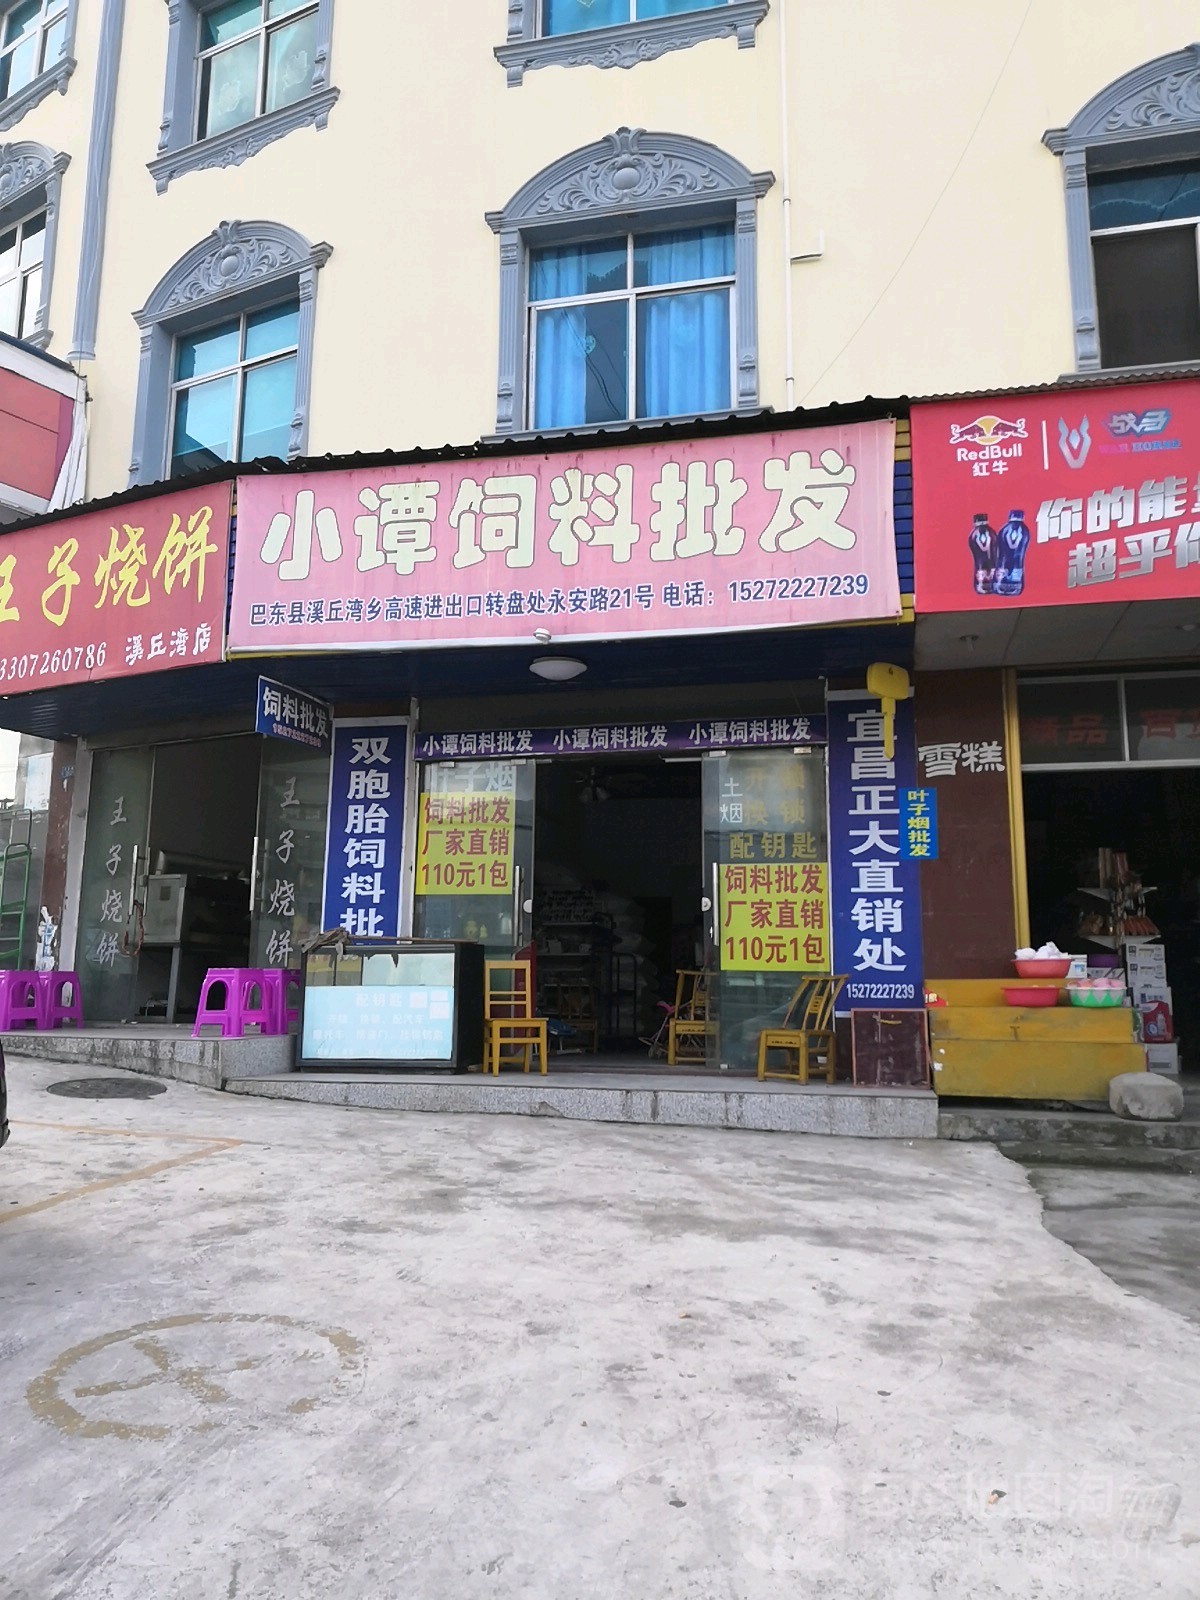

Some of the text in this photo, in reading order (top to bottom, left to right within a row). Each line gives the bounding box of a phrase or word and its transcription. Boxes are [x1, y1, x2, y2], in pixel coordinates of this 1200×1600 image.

[956, 441, 1024, 463] RedBull
[971, 460, 1010, 478] 红牛
[260, 447, 857, 581] 小谭饲料批发
[250, 583, 656, 627] 巴东县溪丘湾乡高速进出口转盘处永安路21号
[125, 622, 212, 666] 溪丘湾店
[262, 686, 329, 739] 饲料批发
[422, 717, 812, 756] 小谭饲料批发 小谭饲料批发 小谭饲料批发
[918, 740, 1006, 779] 雪糕
[424, 795, 511, 825] 饲料批发
[719, 777, 744, 824] 土烟
[340, 737, 392, 945] 双胞胎饲料批
[421, 827, 509, 856] 厂家直销
[846, 709, 907, 972] 宜昌正大直销处
[906, 788, 931, 858] 叶子烟批发
[729, 831, 818, 859] 配钥匙
[96, 796, 127, 968] 王子烧饼
[266, 776, 300, 968] 王子烧饼
[421, 859, 509, 888] 110元1包
[724, 864, 824, 895] 饲料批发
[724, 898, 825, 930] 厂家直销
[725, 933, 826, 964] 110元1包
[846, 981, 915, 1000] 15272227239
